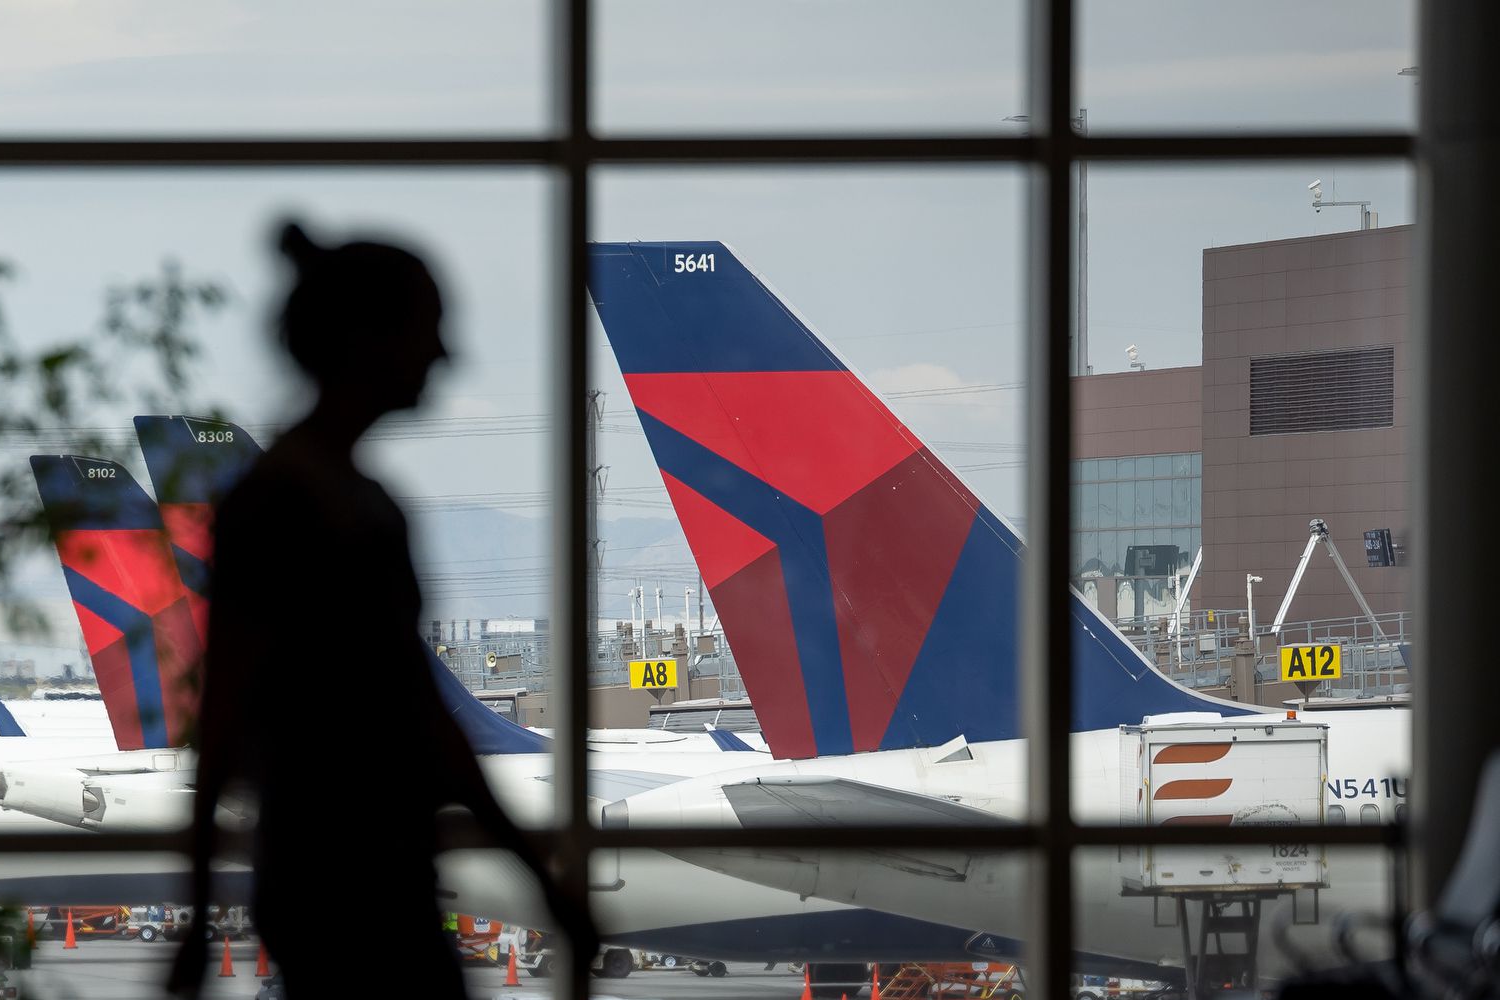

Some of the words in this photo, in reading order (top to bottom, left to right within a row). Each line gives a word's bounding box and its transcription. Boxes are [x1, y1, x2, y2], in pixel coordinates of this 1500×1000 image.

[675, 254, 715, 272] 5641
[198, 431, 234, 443] 8308
[88, 468, 116, 478] 8102
[1288, 646, 1335, 678] A12
[642, 662, 668, 687] A8
[1269, 842, 1309, 858] 1824
